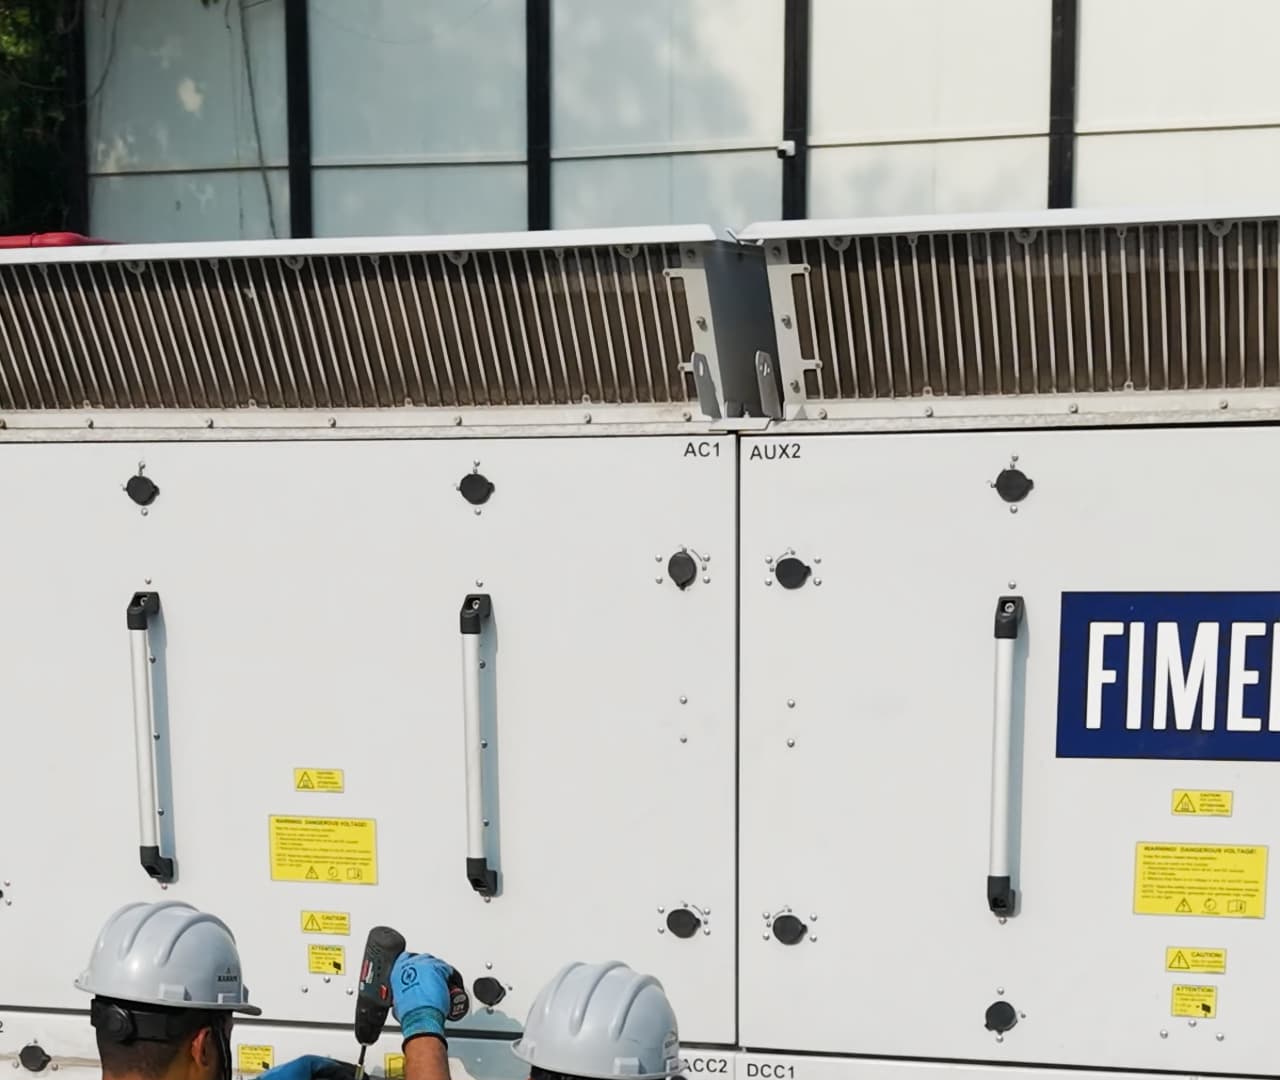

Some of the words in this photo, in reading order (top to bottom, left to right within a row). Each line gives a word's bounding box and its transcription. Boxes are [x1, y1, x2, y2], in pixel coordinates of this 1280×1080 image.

[684, 442, 720, 457] AC1
[750, 443, 801, 460] AUX2
[747, 1063, 794, 1079] DCC1
